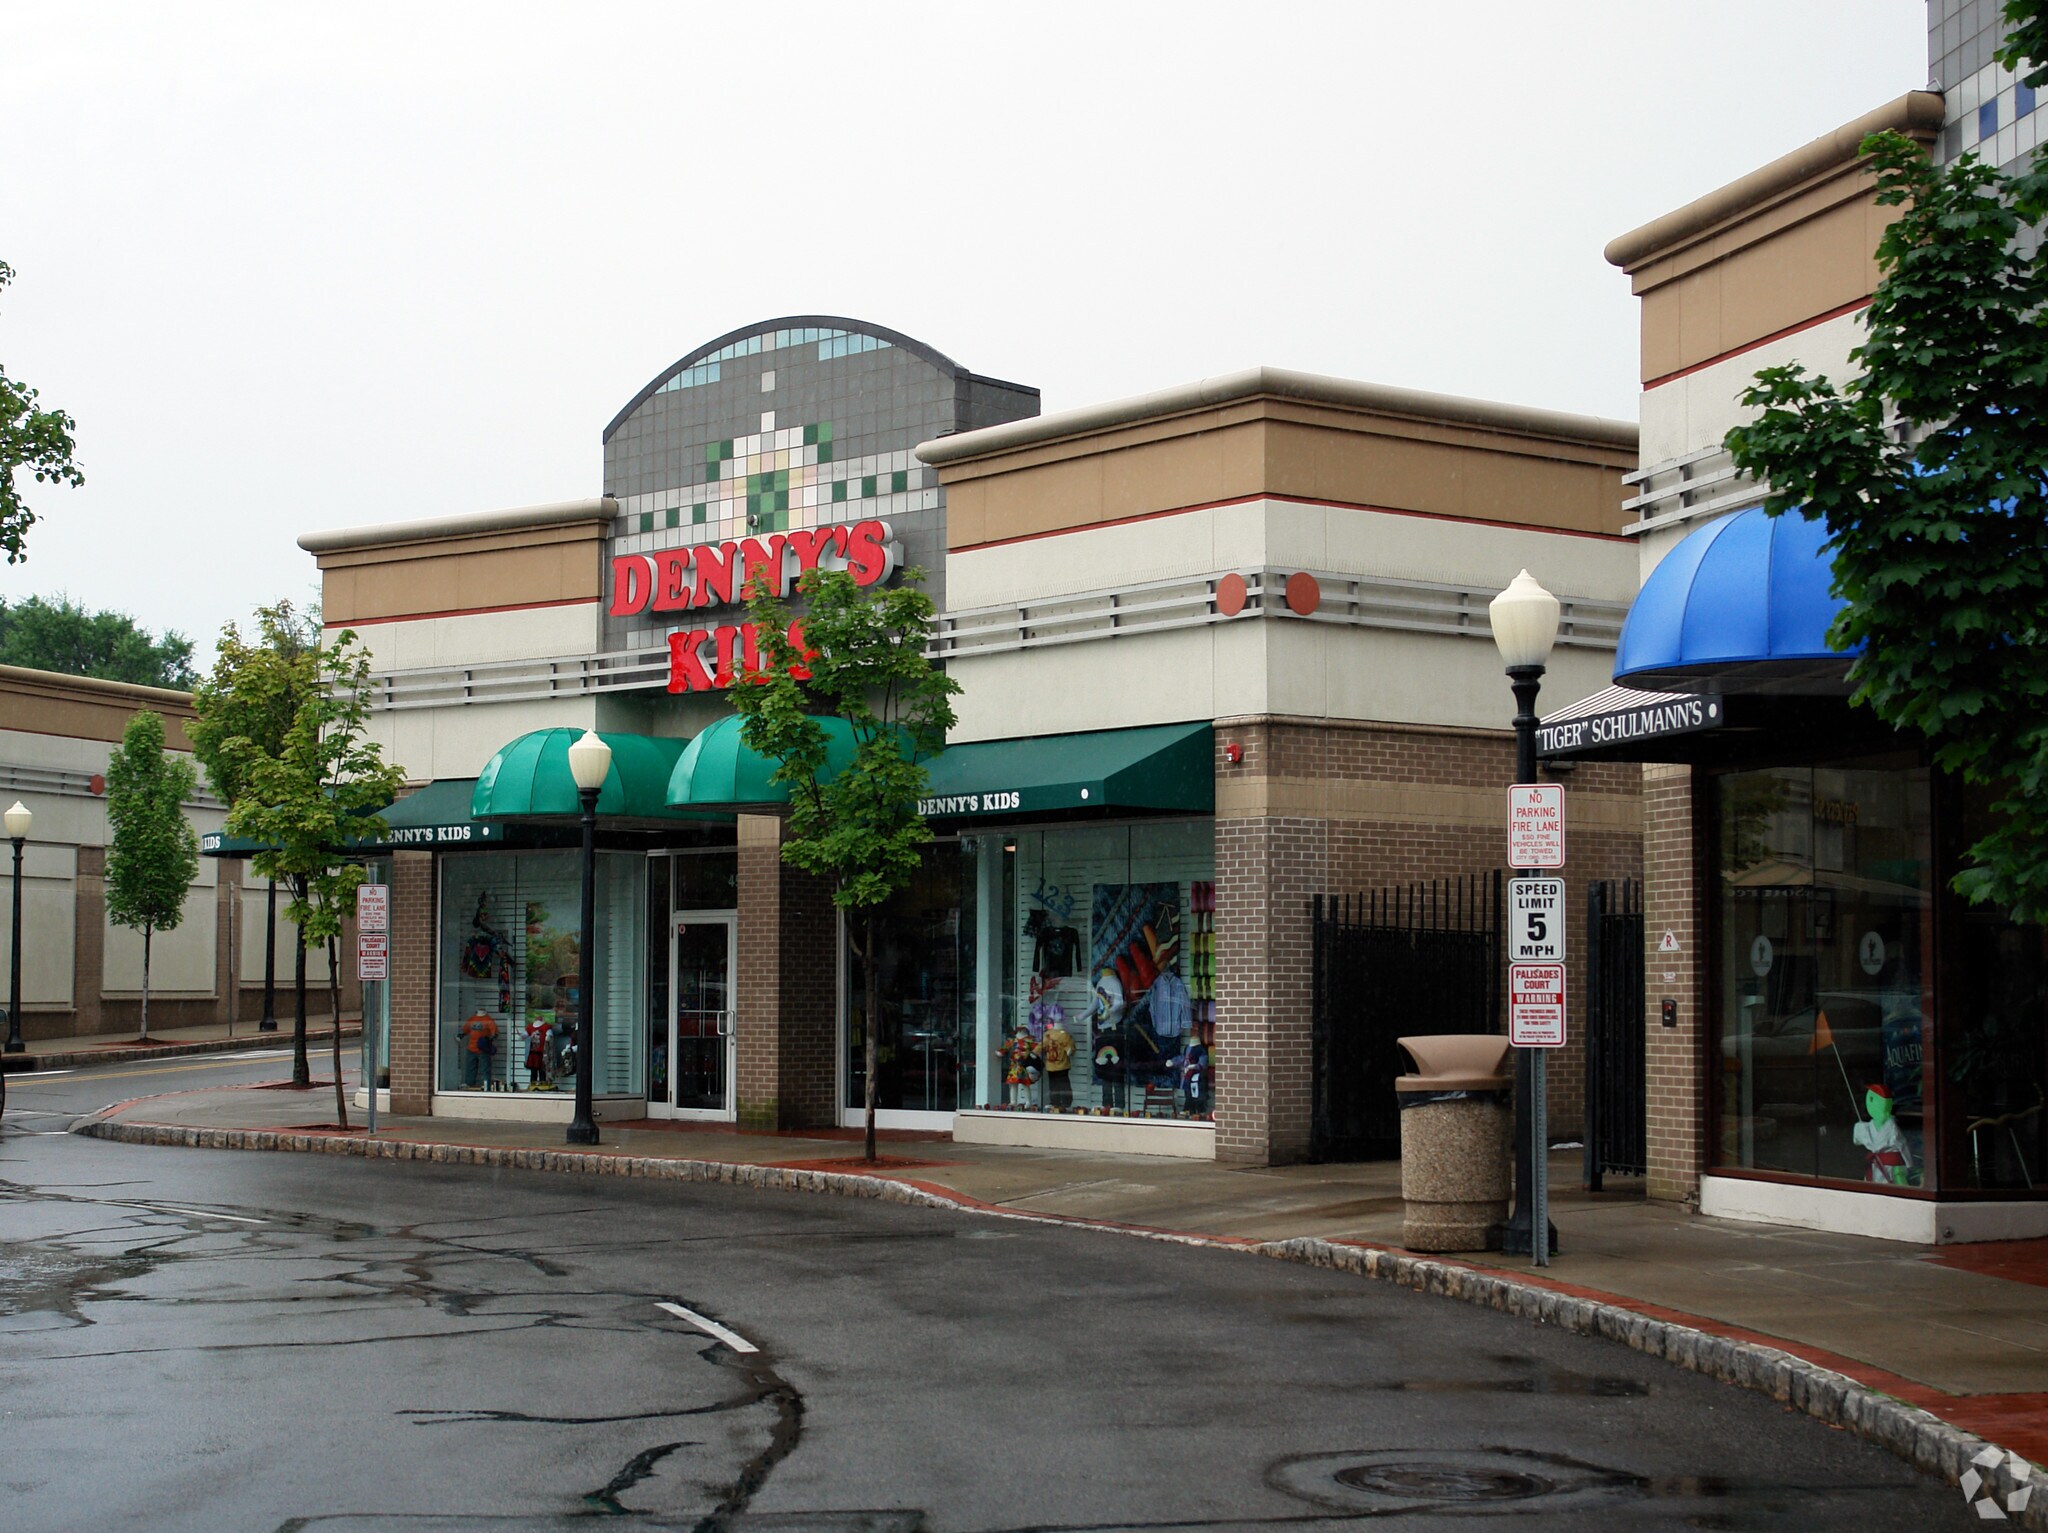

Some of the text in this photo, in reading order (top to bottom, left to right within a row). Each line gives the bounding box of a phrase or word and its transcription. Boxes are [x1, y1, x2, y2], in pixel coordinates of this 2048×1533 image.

[609, 520, 889, 617] DENNY'S
[1591, 700, 1703, 743] SCHULMANN'S
[917, 792, 1020, 816] DENNY'S KIDS
[1529, 793, 1542, 804] NO
[1516, 807, 1556, 818] PARKING
[1512, 821, 1560, 832] FIRE LANE
[437, 825, 471, 841] KIDS
[1515, 884, 1558, 896] SPEED
[1518, 898, 1555, 909] LIMIT
[1527, 913, 1547, 941] 5
[1666, 935, 1672, 948] R
[1519, 945, 1555, 956] MPH
[1516, 970, 1559, 979] PALISADES
[1524, 980, 1550, 989] COURT
[1516, 993, 1557, 1004] WARNING
